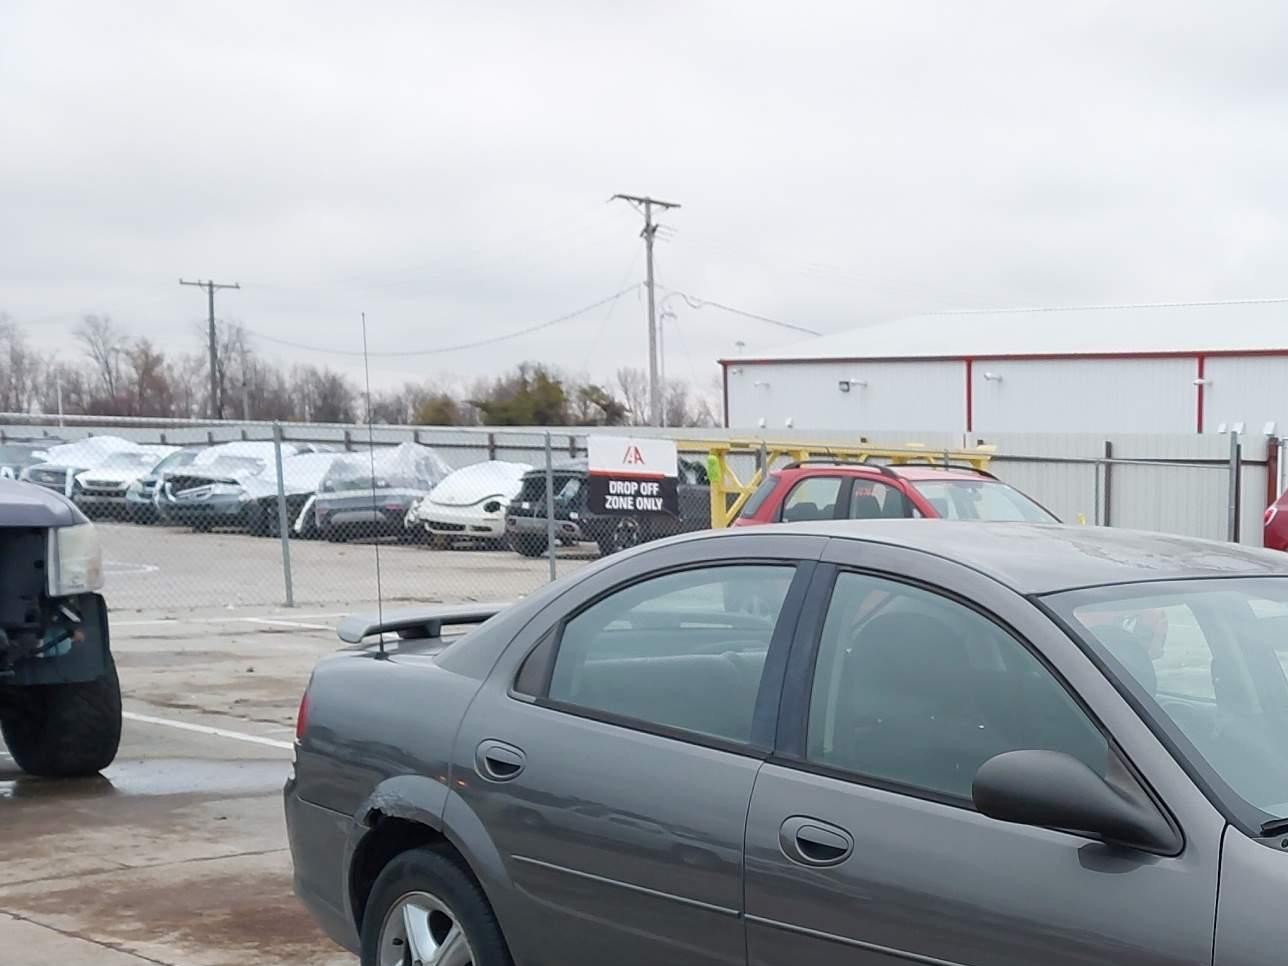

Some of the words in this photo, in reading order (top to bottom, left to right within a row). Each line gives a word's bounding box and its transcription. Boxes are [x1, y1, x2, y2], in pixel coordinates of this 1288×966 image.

[608, 480, 638, 495] DROP
[640, 482, 660, 496] OFF
[605, 496, 634, 510] ZONE
[635, 496, 664, 511] ONLY
